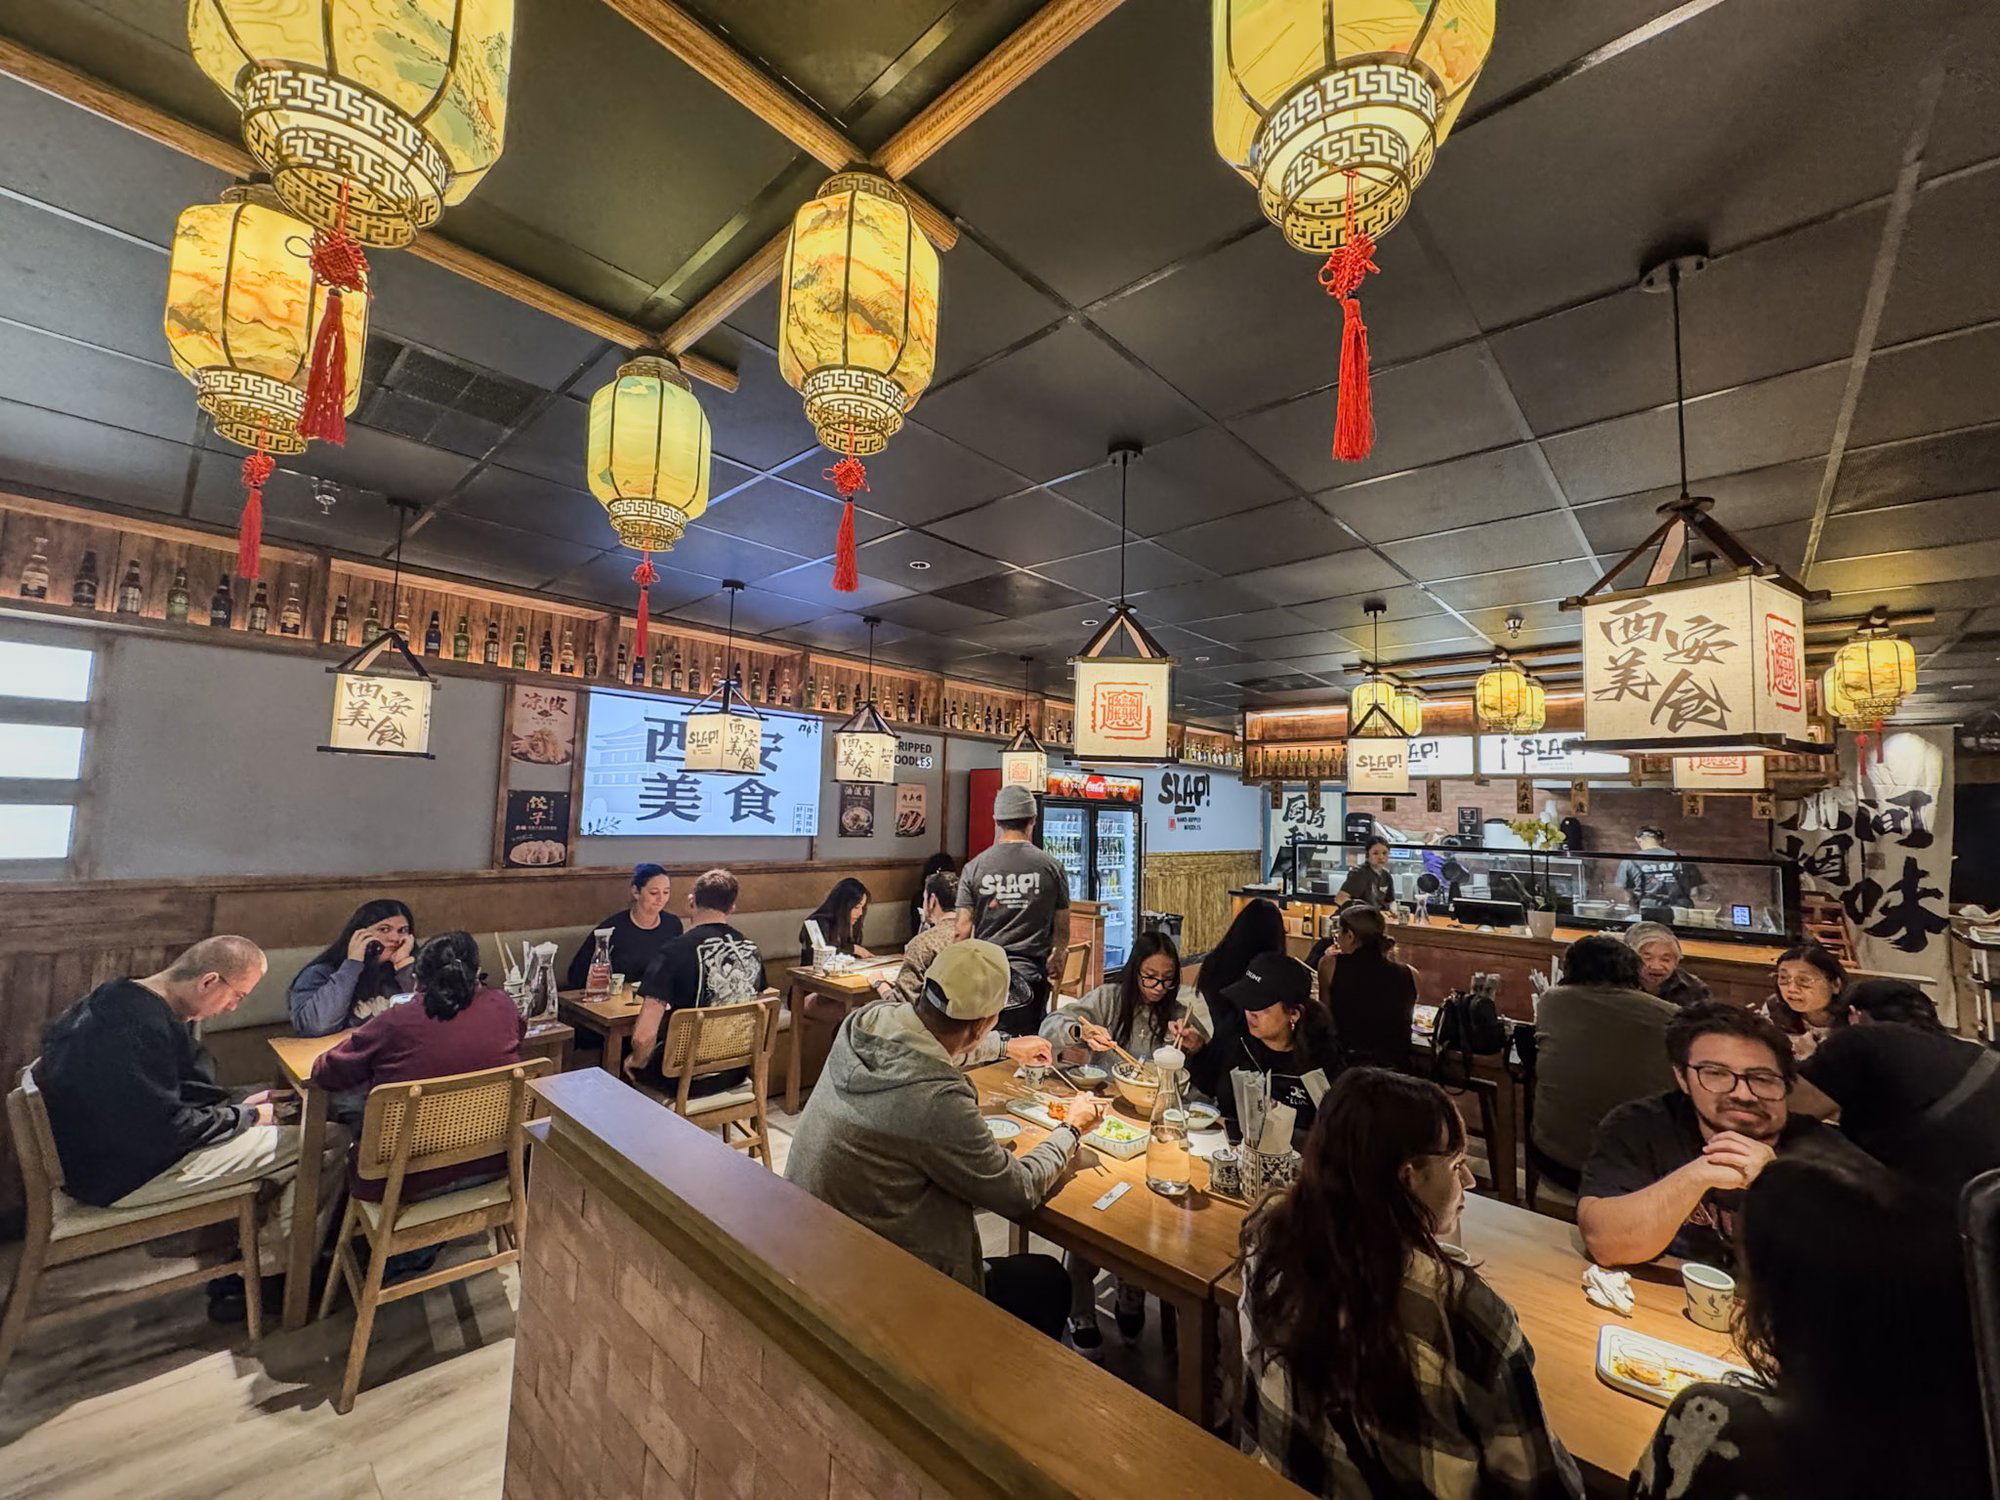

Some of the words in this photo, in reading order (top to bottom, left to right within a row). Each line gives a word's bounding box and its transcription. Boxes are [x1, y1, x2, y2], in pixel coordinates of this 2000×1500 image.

[1599, 599, 1739, 665] 西安
[345, 677, 415, 717] 西安
[1592, 646, 1732, 733] 美食
[337, 699, 407, 748] 美食
[894, 755, 932, 768] OODLES
[1355, 753, 1402, 769] SLAP!
[1408, 741, 1440, 759] AP!
[636, 771, 782, 825] 美食
[1158, 772, 1211, 807] SLAP!
[979, 872, 1040, 896] SLAP!
